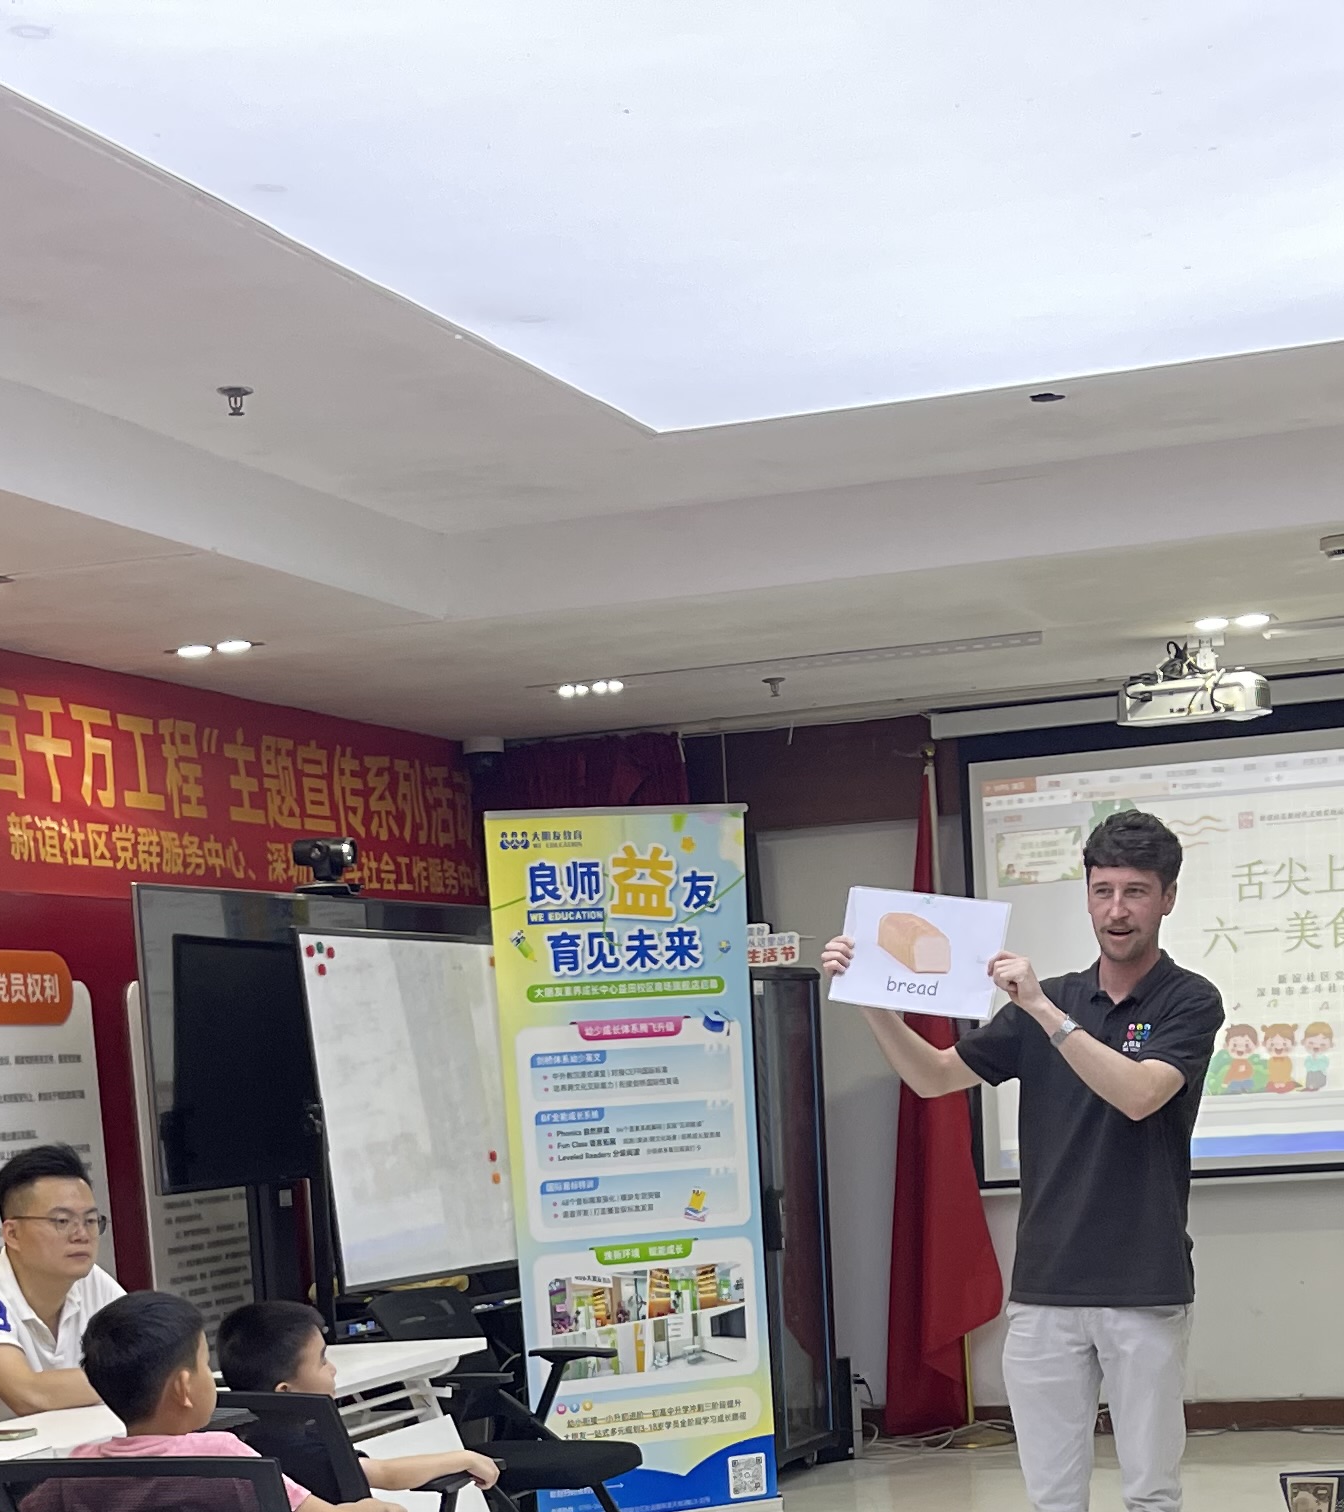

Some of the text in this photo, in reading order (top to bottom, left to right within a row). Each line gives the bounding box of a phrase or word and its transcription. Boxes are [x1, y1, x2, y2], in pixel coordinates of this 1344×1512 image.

[529, 845, 716, 917] 良师益友
[529, 910, 603, 922] WE EDUCATION
[547, 927, 700, 973] 育见未来
[886, 975, 939, 996] bread
